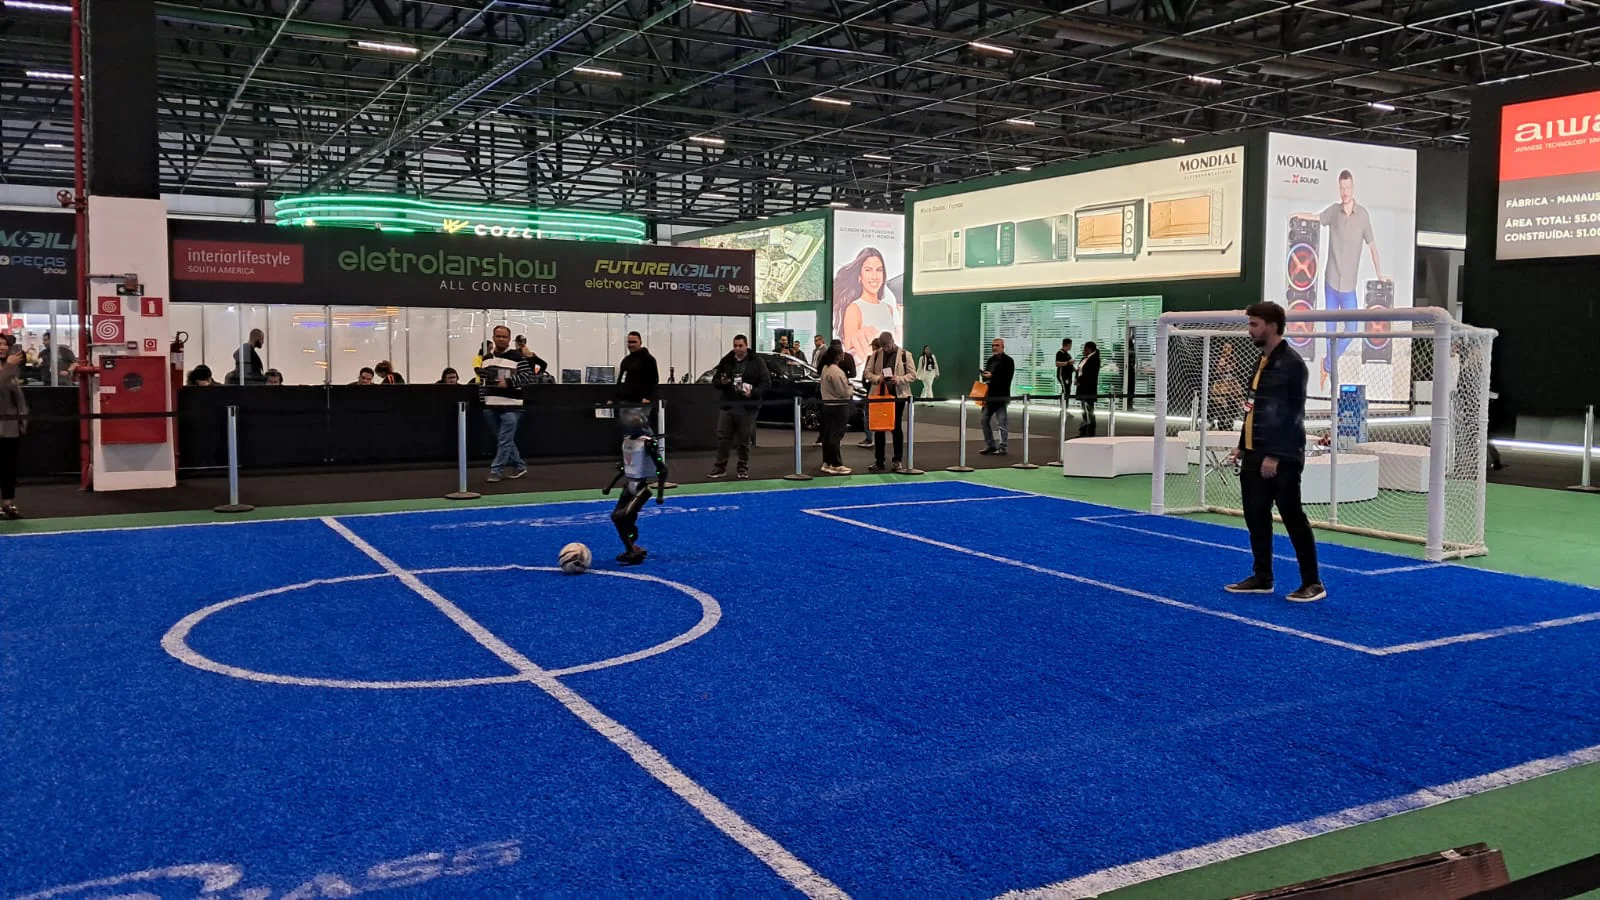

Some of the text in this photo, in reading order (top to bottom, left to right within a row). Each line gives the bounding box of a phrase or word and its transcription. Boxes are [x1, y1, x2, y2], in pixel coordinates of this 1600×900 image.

[1514, 143, 1543, 153] JAPANESE
[1546, 138, 1587, 149] TECHNOLOGY
[1179, 152, 1238, 172] MONDIAL
[1276, 153, 1329, 171] MONDIAL
[1300, 176, 1320, 184] SOUND
[1506, 196, 1549, 208] FÁBRICA
[1505, 217, 1532, 228] ÁREA
[1536, 215, 1572, 226] TOTAL:
[1504, 229, 1573, 242] CONSTRUÍDA:
[187, 248, 291, 268] interiorlifestyle
[338, 245, 557, 280] eletrolarshow
[43, 267, 67, 275] show
[187, 265, 255, 275] SOUTH AMERICA
[439, 279, 558, 295] ALL CONNECTED
[584, 278, 644, 290] eletrocar
[648, 281, 712, 294] AUTOPEÇAS
[718, 283, 750, 295] e-bike
